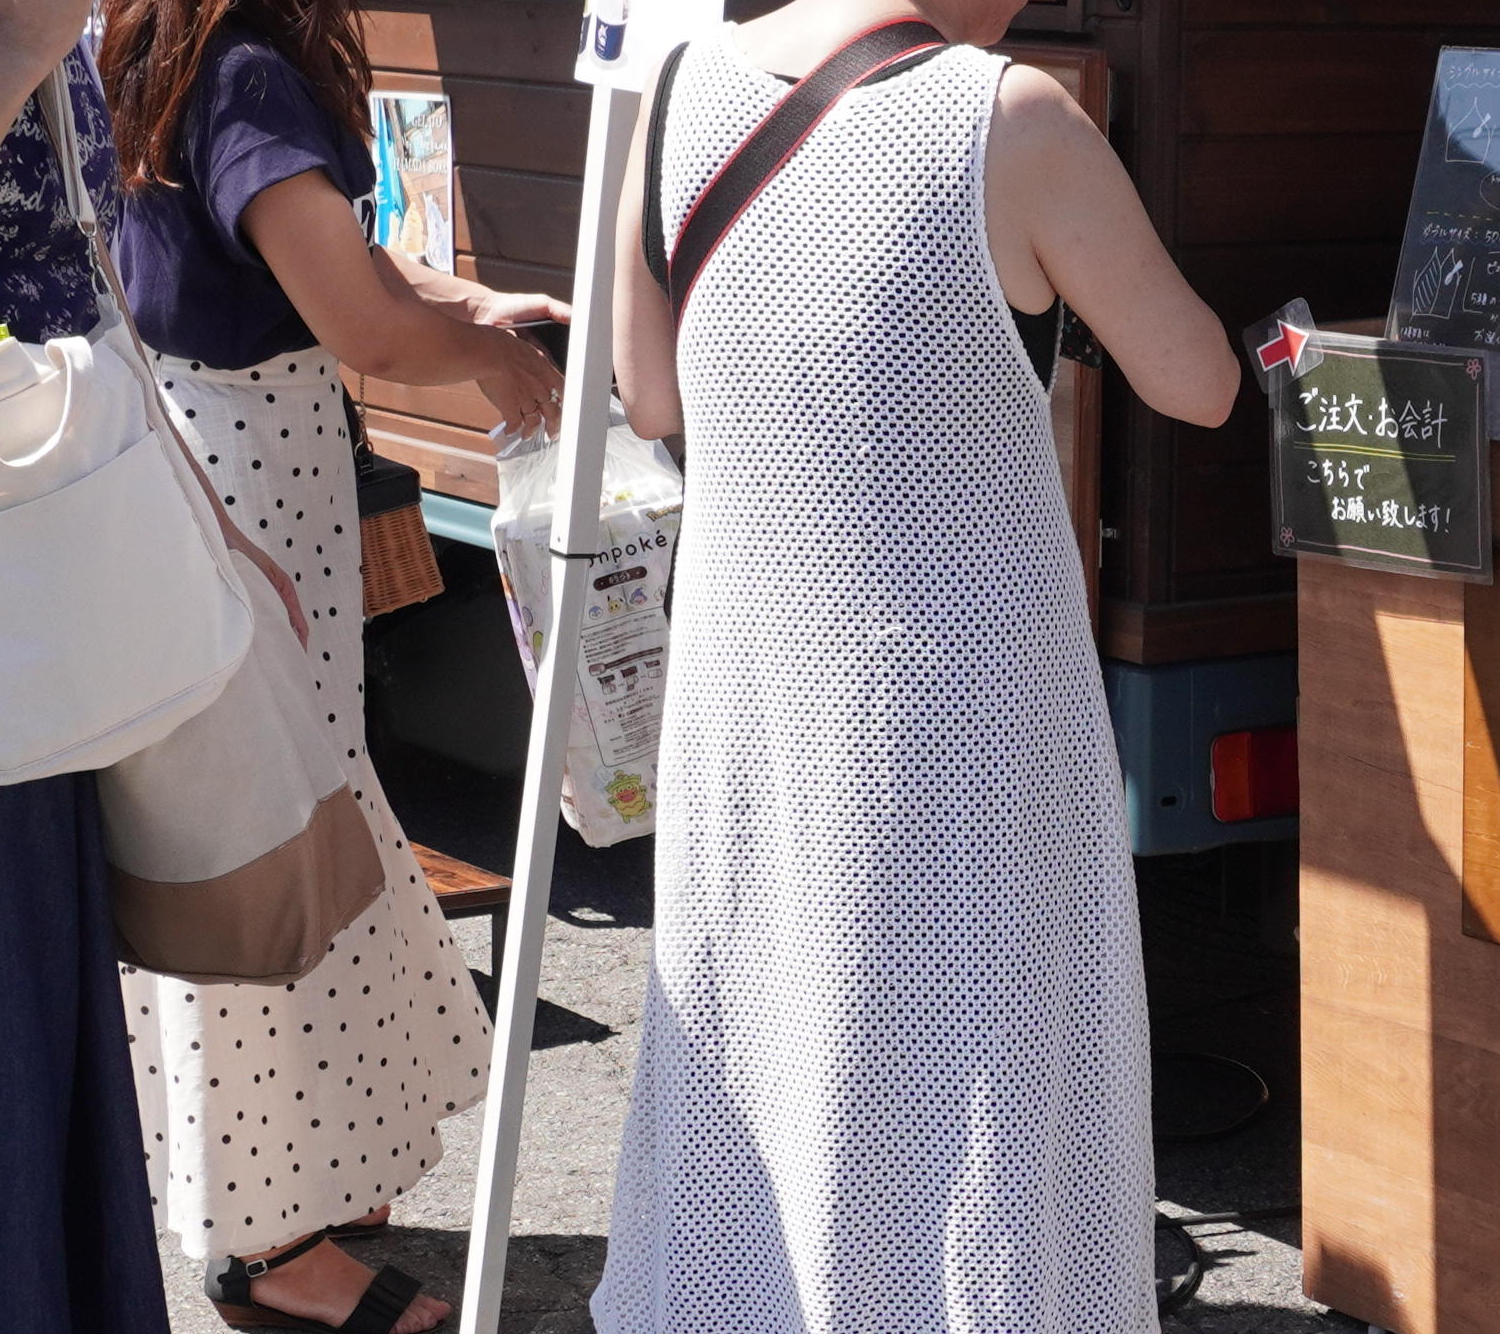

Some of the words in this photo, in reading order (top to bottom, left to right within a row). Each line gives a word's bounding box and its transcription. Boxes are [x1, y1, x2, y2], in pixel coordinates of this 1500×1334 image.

[1296, 387, 1448, 449] ご注文・お会計
[1306, 459, 1371, 490] こちらで
